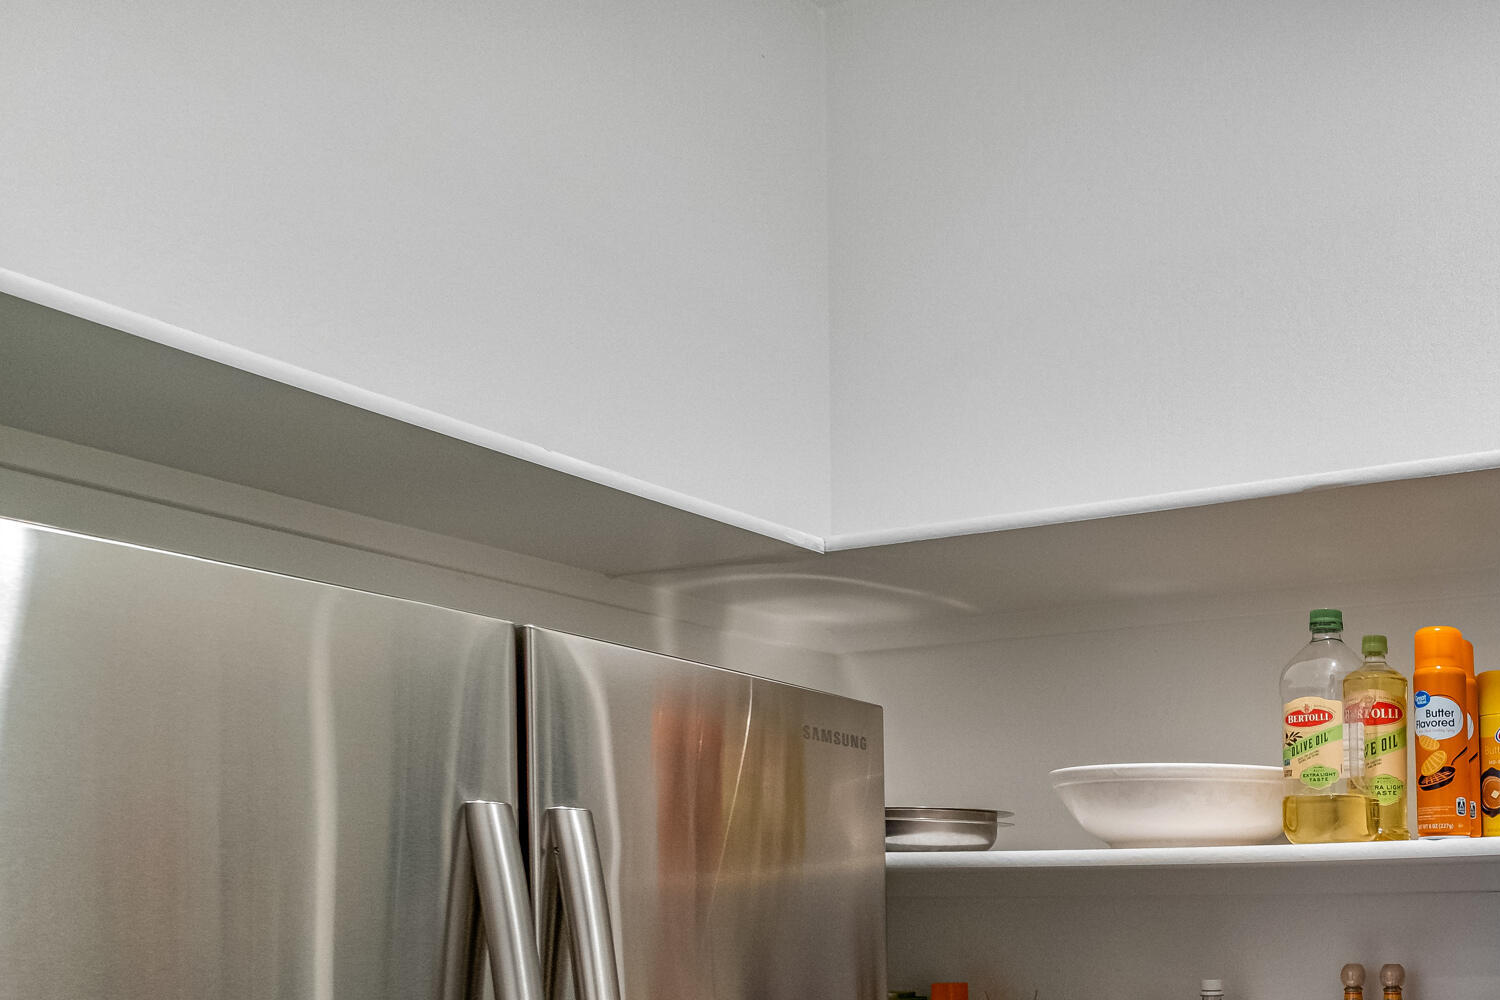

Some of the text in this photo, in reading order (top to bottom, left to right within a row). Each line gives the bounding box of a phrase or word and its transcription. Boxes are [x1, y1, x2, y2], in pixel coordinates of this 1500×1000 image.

[1288, 712, 1329, 724] BERTOLLI
[1425, 709, 1455, 718] Butter
[1416, 718, 1455, 729] Flavored
[802, 725, 867, 750] SAMSUNG
[1291, 738, 1313, 757] OLIVE
[1316, 732, 1329, 746] OIL
[1381, 735, 1398, 752] OIL
